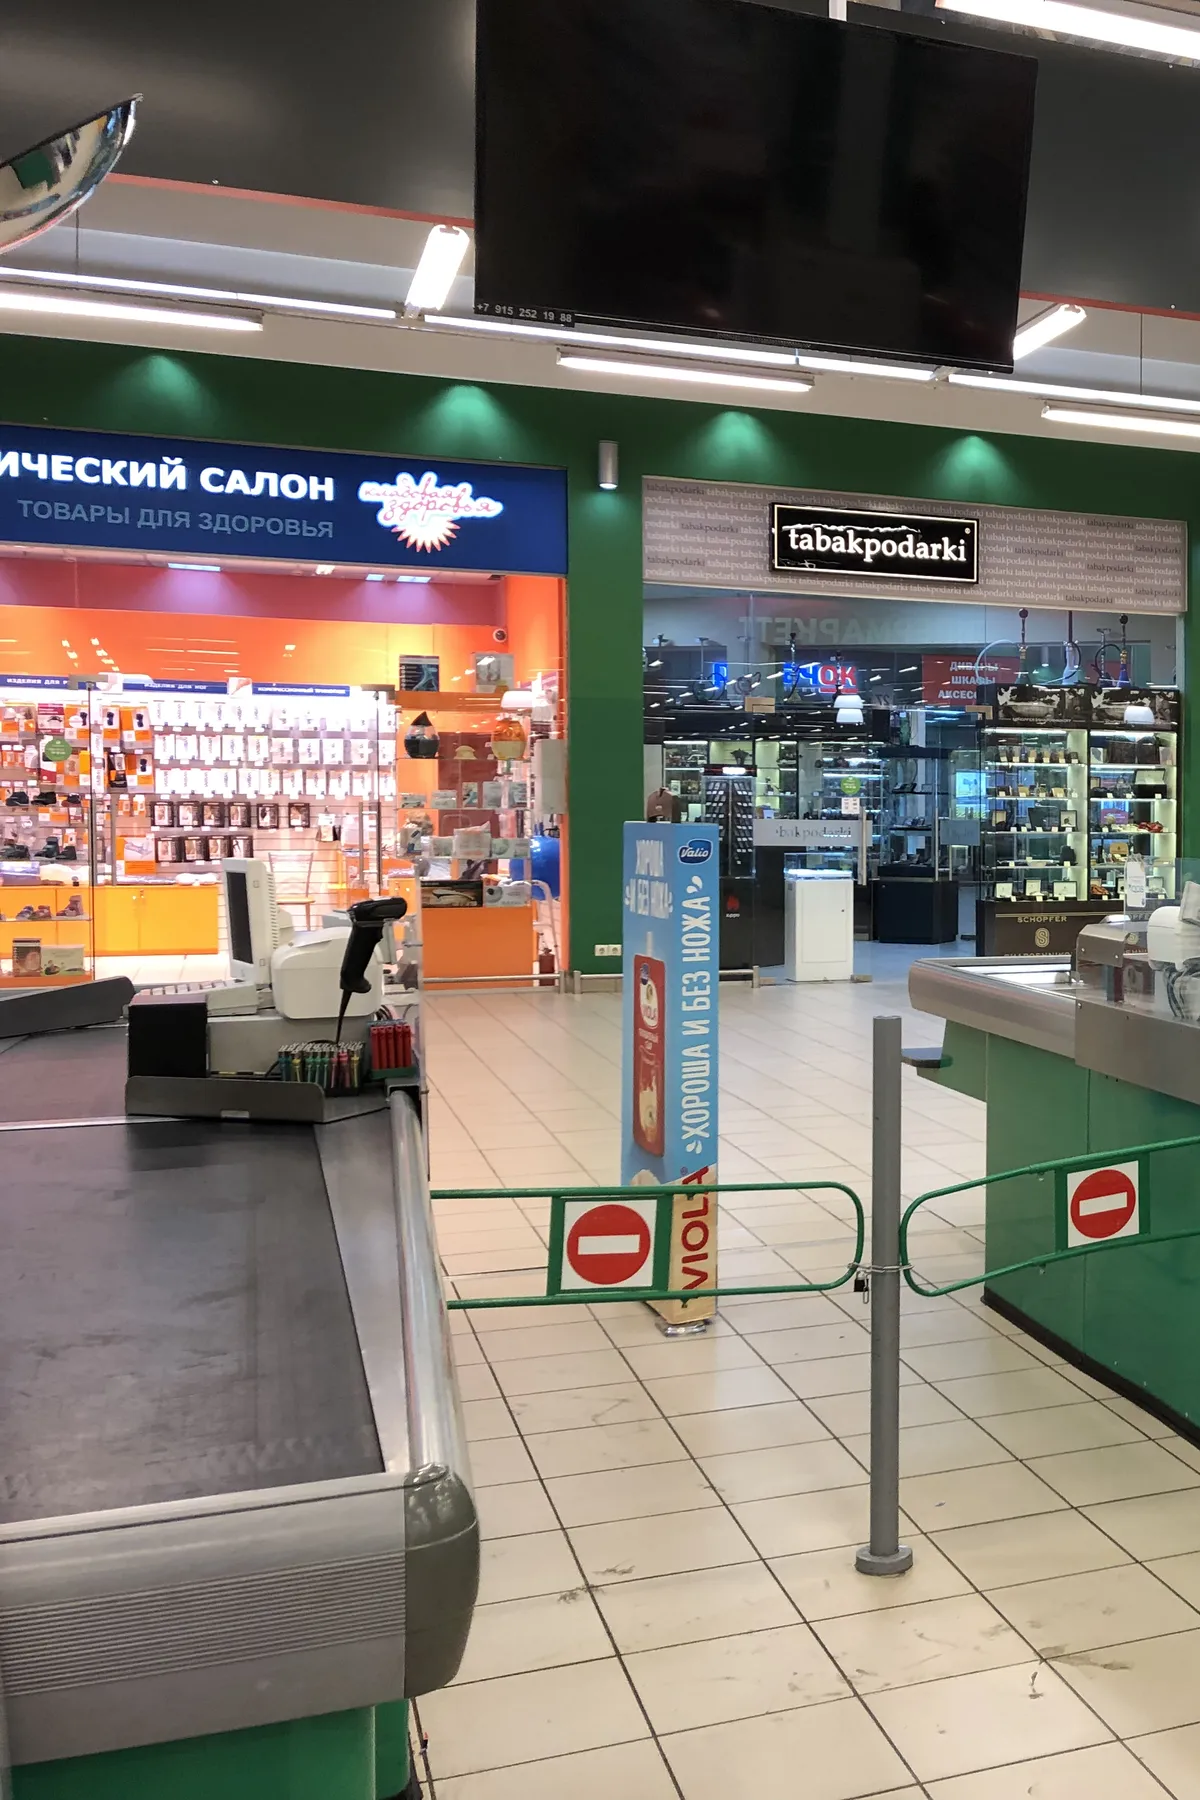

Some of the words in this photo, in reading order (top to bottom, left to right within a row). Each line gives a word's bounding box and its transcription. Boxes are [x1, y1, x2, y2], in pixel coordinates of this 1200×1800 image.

[477, 302, 489, 312] +7
[495, 305, 514, 316] 915
[519, 309, 538, 320] 252
[543, 311, 555, 321] 19
[560, 313, 573, 324] 88
[0, 450, 186, 491] ИЧЕСКИЙ
[199, 466, 334, 501] САЛОН
[16, 499, 130, 525] ТОВАРЫ
[136, 508, 191, 529] ДЛЯ
[198, 511, 334, 538] ЗДОРОВЬЯ
[788, 526, 967, 562] tabakpodarki
[949, 661, 999, 672] ДИВАНЫ
[951, 675, 996, 686] ШКАФЫ
[680, 847, 709, 859] Valio
[681, 896, 711, 963] НОЖА
[682, 969, 711, 1013] БЕЗ
[682, 1018, 711, 1037] И
[681, 1042, 711, 1140] ХОРОША
[681, 1165, 710, 1291] VIOLA
